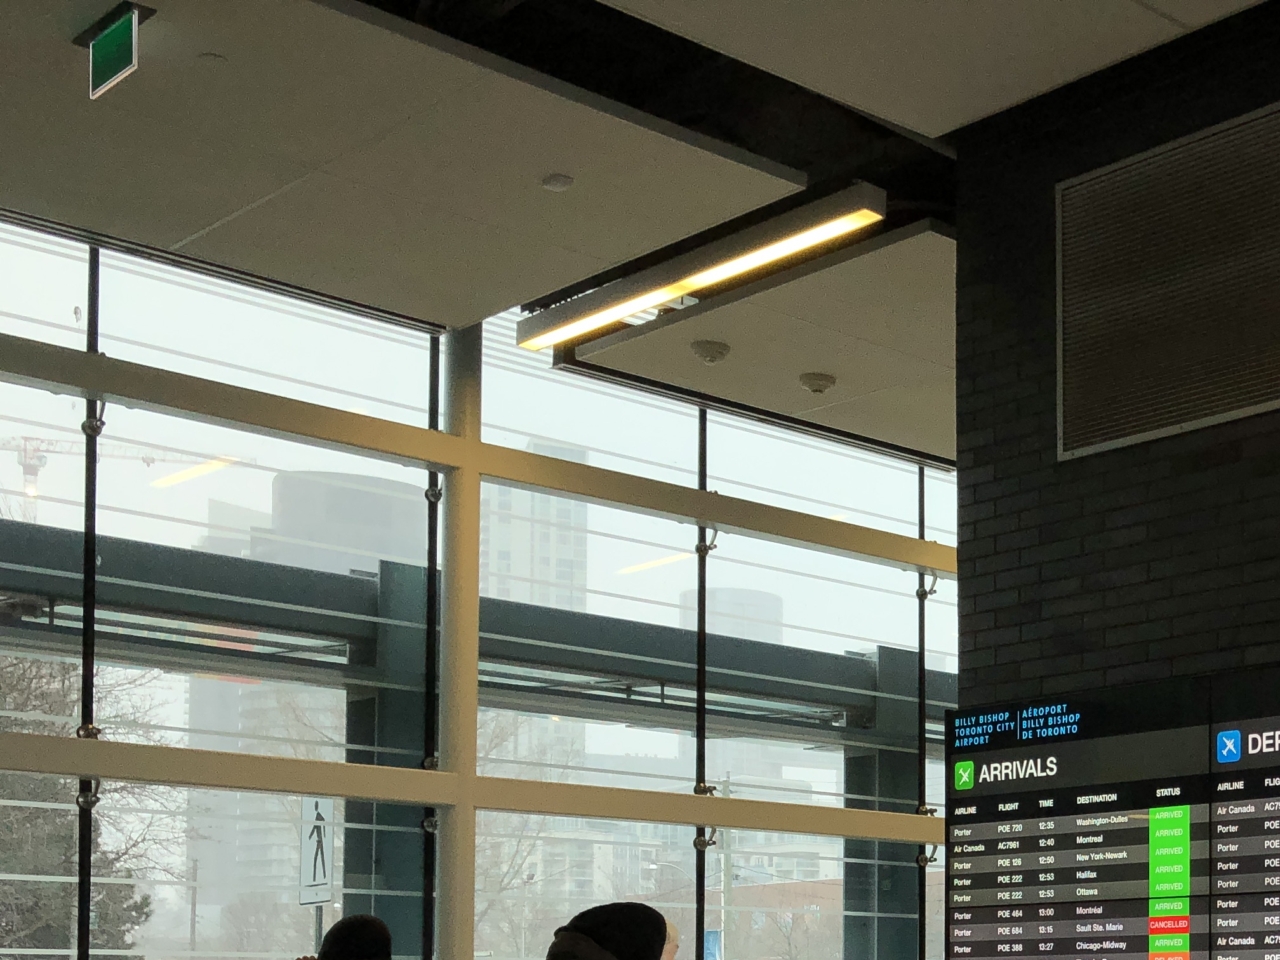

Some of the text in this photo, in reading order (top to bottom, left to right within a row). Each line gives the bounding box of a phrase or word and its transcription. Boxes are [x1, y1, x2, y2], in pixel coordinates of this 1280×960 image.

[1022, 703, 1067, 718] AÉROPORT
[955, 712, 1010, 727] BILLY BISHOP
[1022, 713, 1080, 729] BILLY BISHOP
[955, 722, 1015, 737] TORONTO CITY
[1022, 725, 1078, 740] DE TORONTO
[955, 736, 989, 747] AIRPORT
[979, 757, 1057, 783] ARRIVALS
[1217, 780, 1244, 791] AIRLINE
[954, 787, 1180, 815] AIRLINE FLIGHT TIME DESTINATION STATUS
[1217, 804, 1227, 815] Air
[1229, 803, 1255, 814] Canada
[954, 828, 971, 837] Porter
[998, 824, 1010, 833] POE
[1039, 821, 1054, 830] 12:35
[1076, 814, 1128, 827] Washington-Dulles
[1155, 810, 1183, 819] ARRIVED
[1217, 823, 1238, 834] Porter
[1264, 819, 1280, 829] POE
[963, 844, 985, 852] Canada
[1039, 838, 1054, 847] 12:40
[1076, 834, 1103, 844] Montreal
[1155, 828, 1183, 837] ARRIVED
[1217, 899, 1238, 909] Porter
[1264, 895, 1280, 906] POE
[954, 928, 971, 937] Porter
[998, 926, 1010, 935] POE
[1039, 925, 1053, 934] 13:15
[1106, 922, 1124, 932] Marie
[1150, 919, 1188, 929] CANCELLED
[1217, 917, 1238, 927] Porter
[1264, 916, 1280, 926] POE
